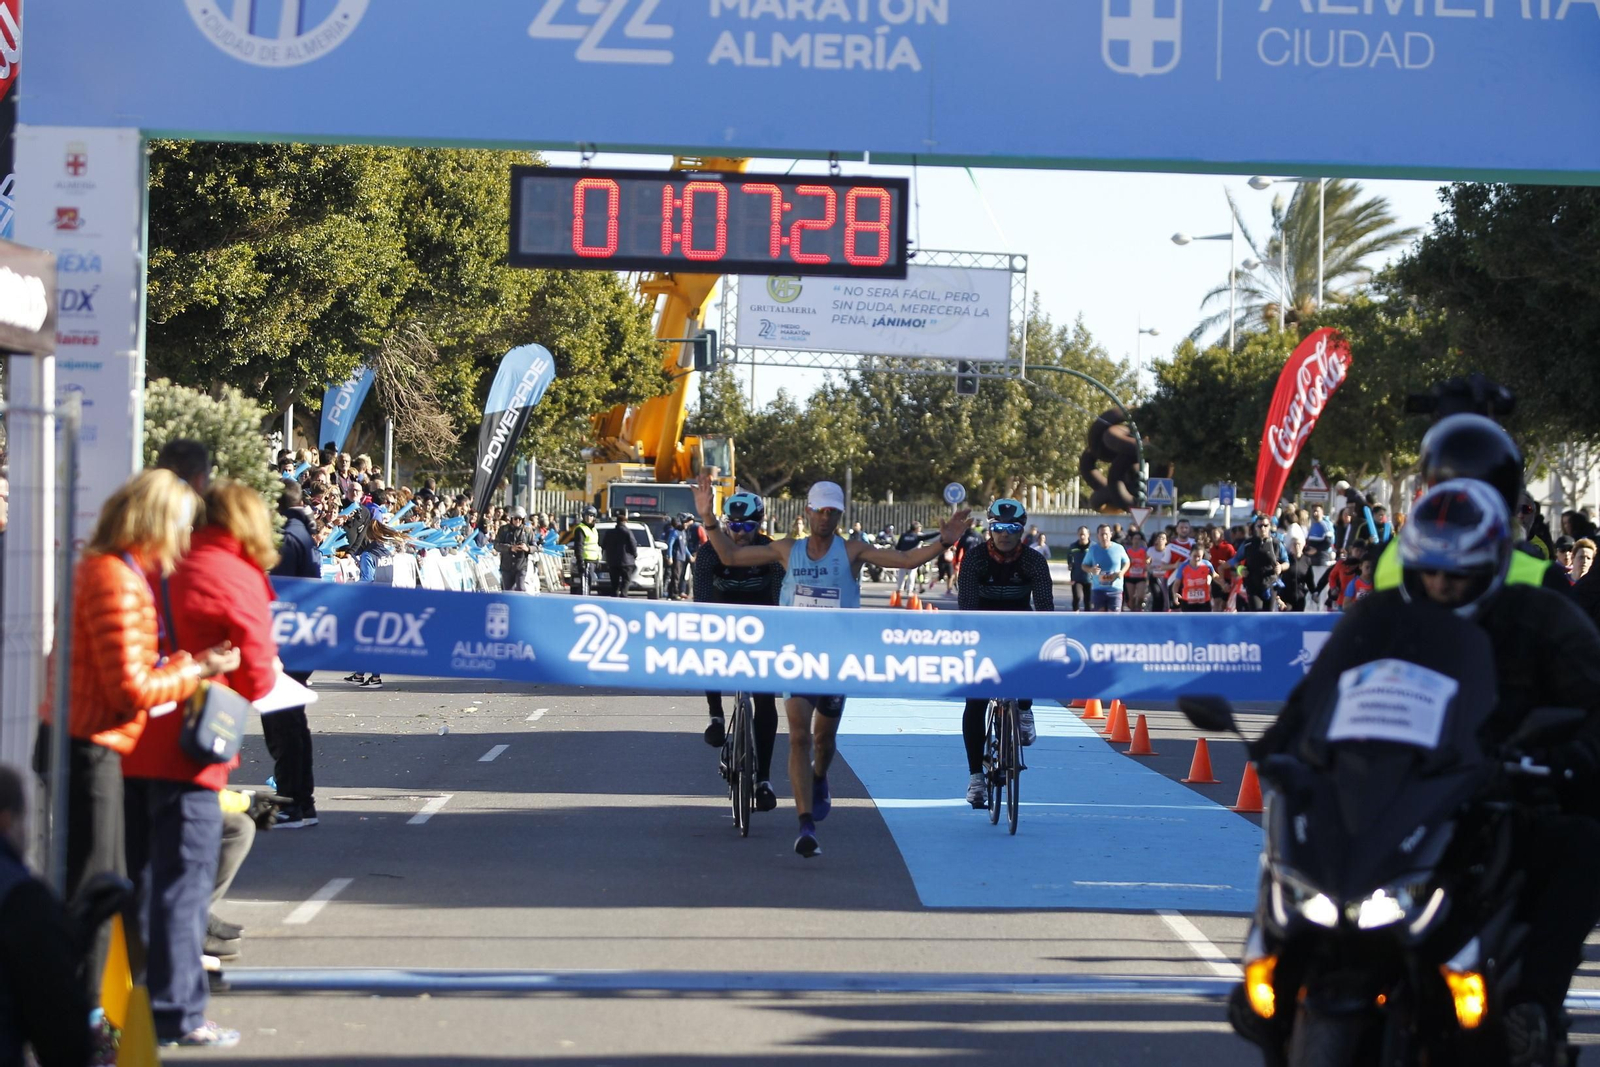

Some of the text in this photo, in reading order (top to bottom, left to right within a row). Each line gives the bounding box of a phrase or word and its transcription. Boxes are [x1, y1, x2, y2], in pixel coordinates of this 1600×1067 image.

[707, 25, 923, 72] ALMERÍA
[1256, 26, 1436, 70] CIUDAD
[843, 286, 865, 298] NO
[866, 286, 900, 300] SERÁ
[902, 286, 942, 302] FÁCIL,
[944, 291, 981, 303] PERO
[749, 304, 817, 315] GRUTALMERIA
[831, 299, 990, 318] SIN DUDA, MERECERÁ LA
[871, 315, 927, 329] ¡ÁNIMO!
[480, 356, 550, 476] POWERADE
[792, 565, 829, 579] nerja
[354, 608, 435, 647] CDX
[644, 610, 765, 645] MEDIO
[881, 628, 981, 647] 03/02/2019
[451, 640, 536, 662] ALMERÍA
[644, 645, 1002, 685] MARATÓN ALMERÍA
